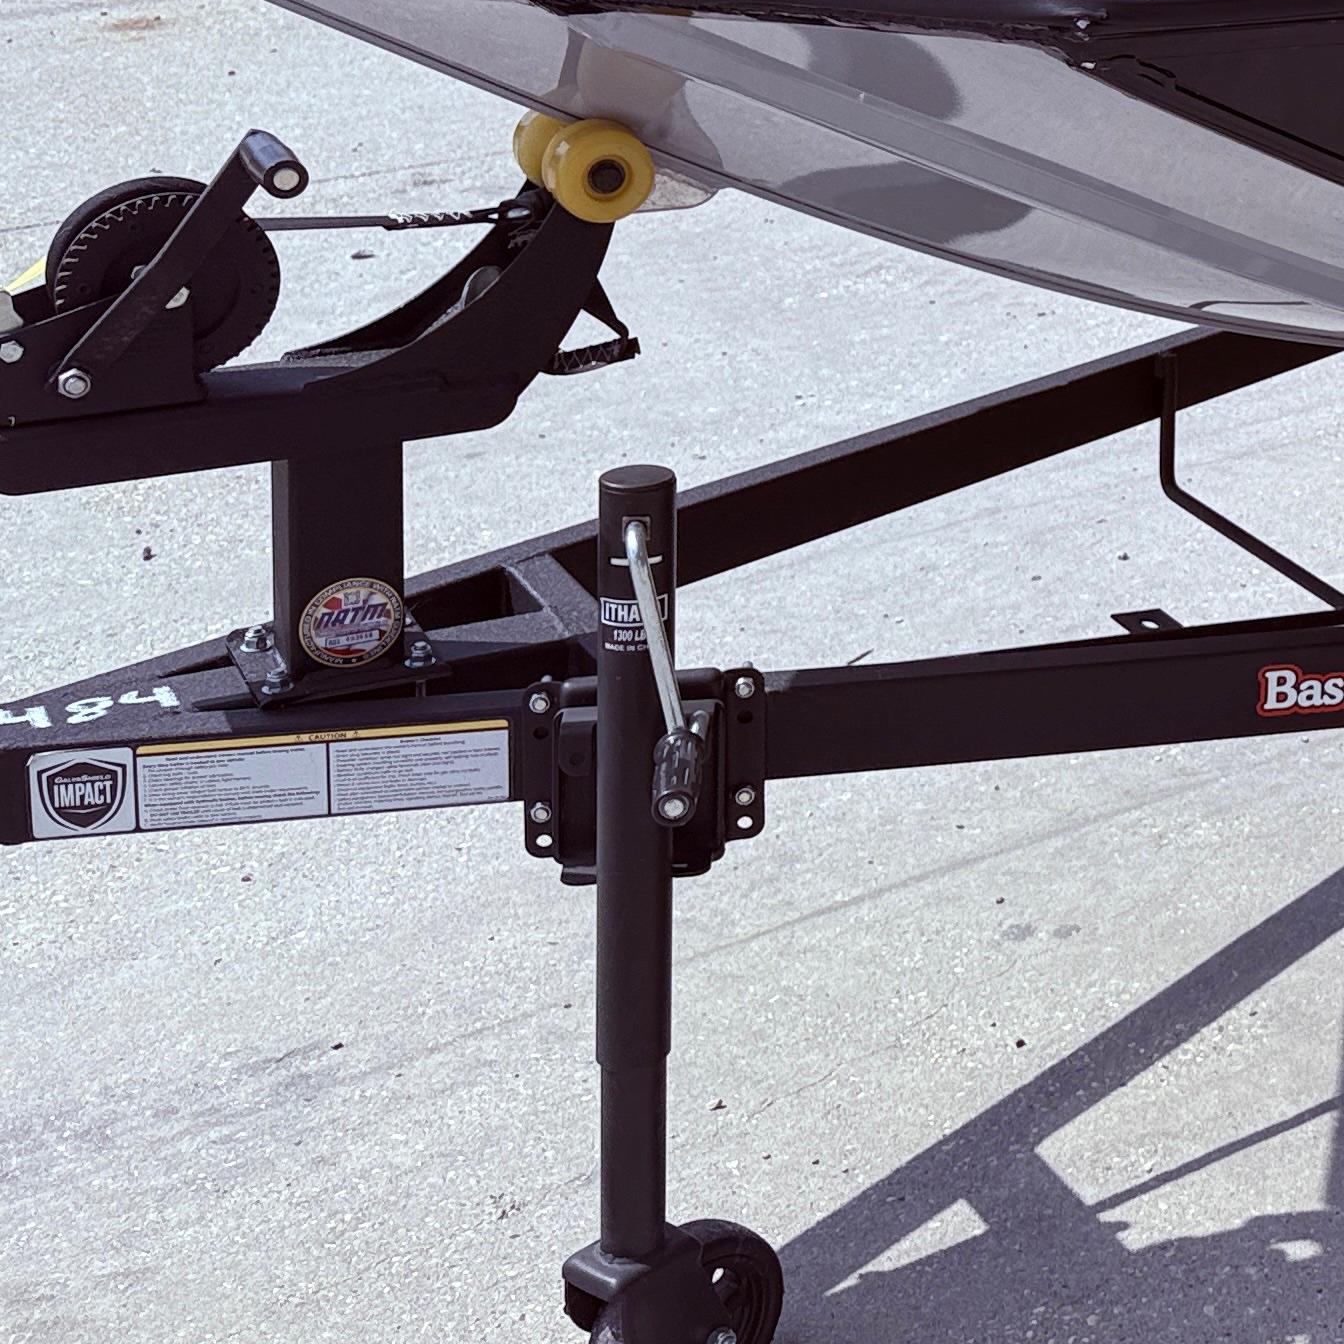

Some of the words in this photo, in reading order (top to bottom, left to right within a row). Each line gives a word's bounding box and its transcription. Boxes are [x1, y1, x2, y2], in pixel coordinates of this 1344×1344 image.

[605, 602, 641, 623] ITHA
[613, 629, 633, 642] 1300
[634, 629, 647, 642] LB
[308, 732, 347, 742] CAUTION
[53, 781, 113, 808] IMPACT
